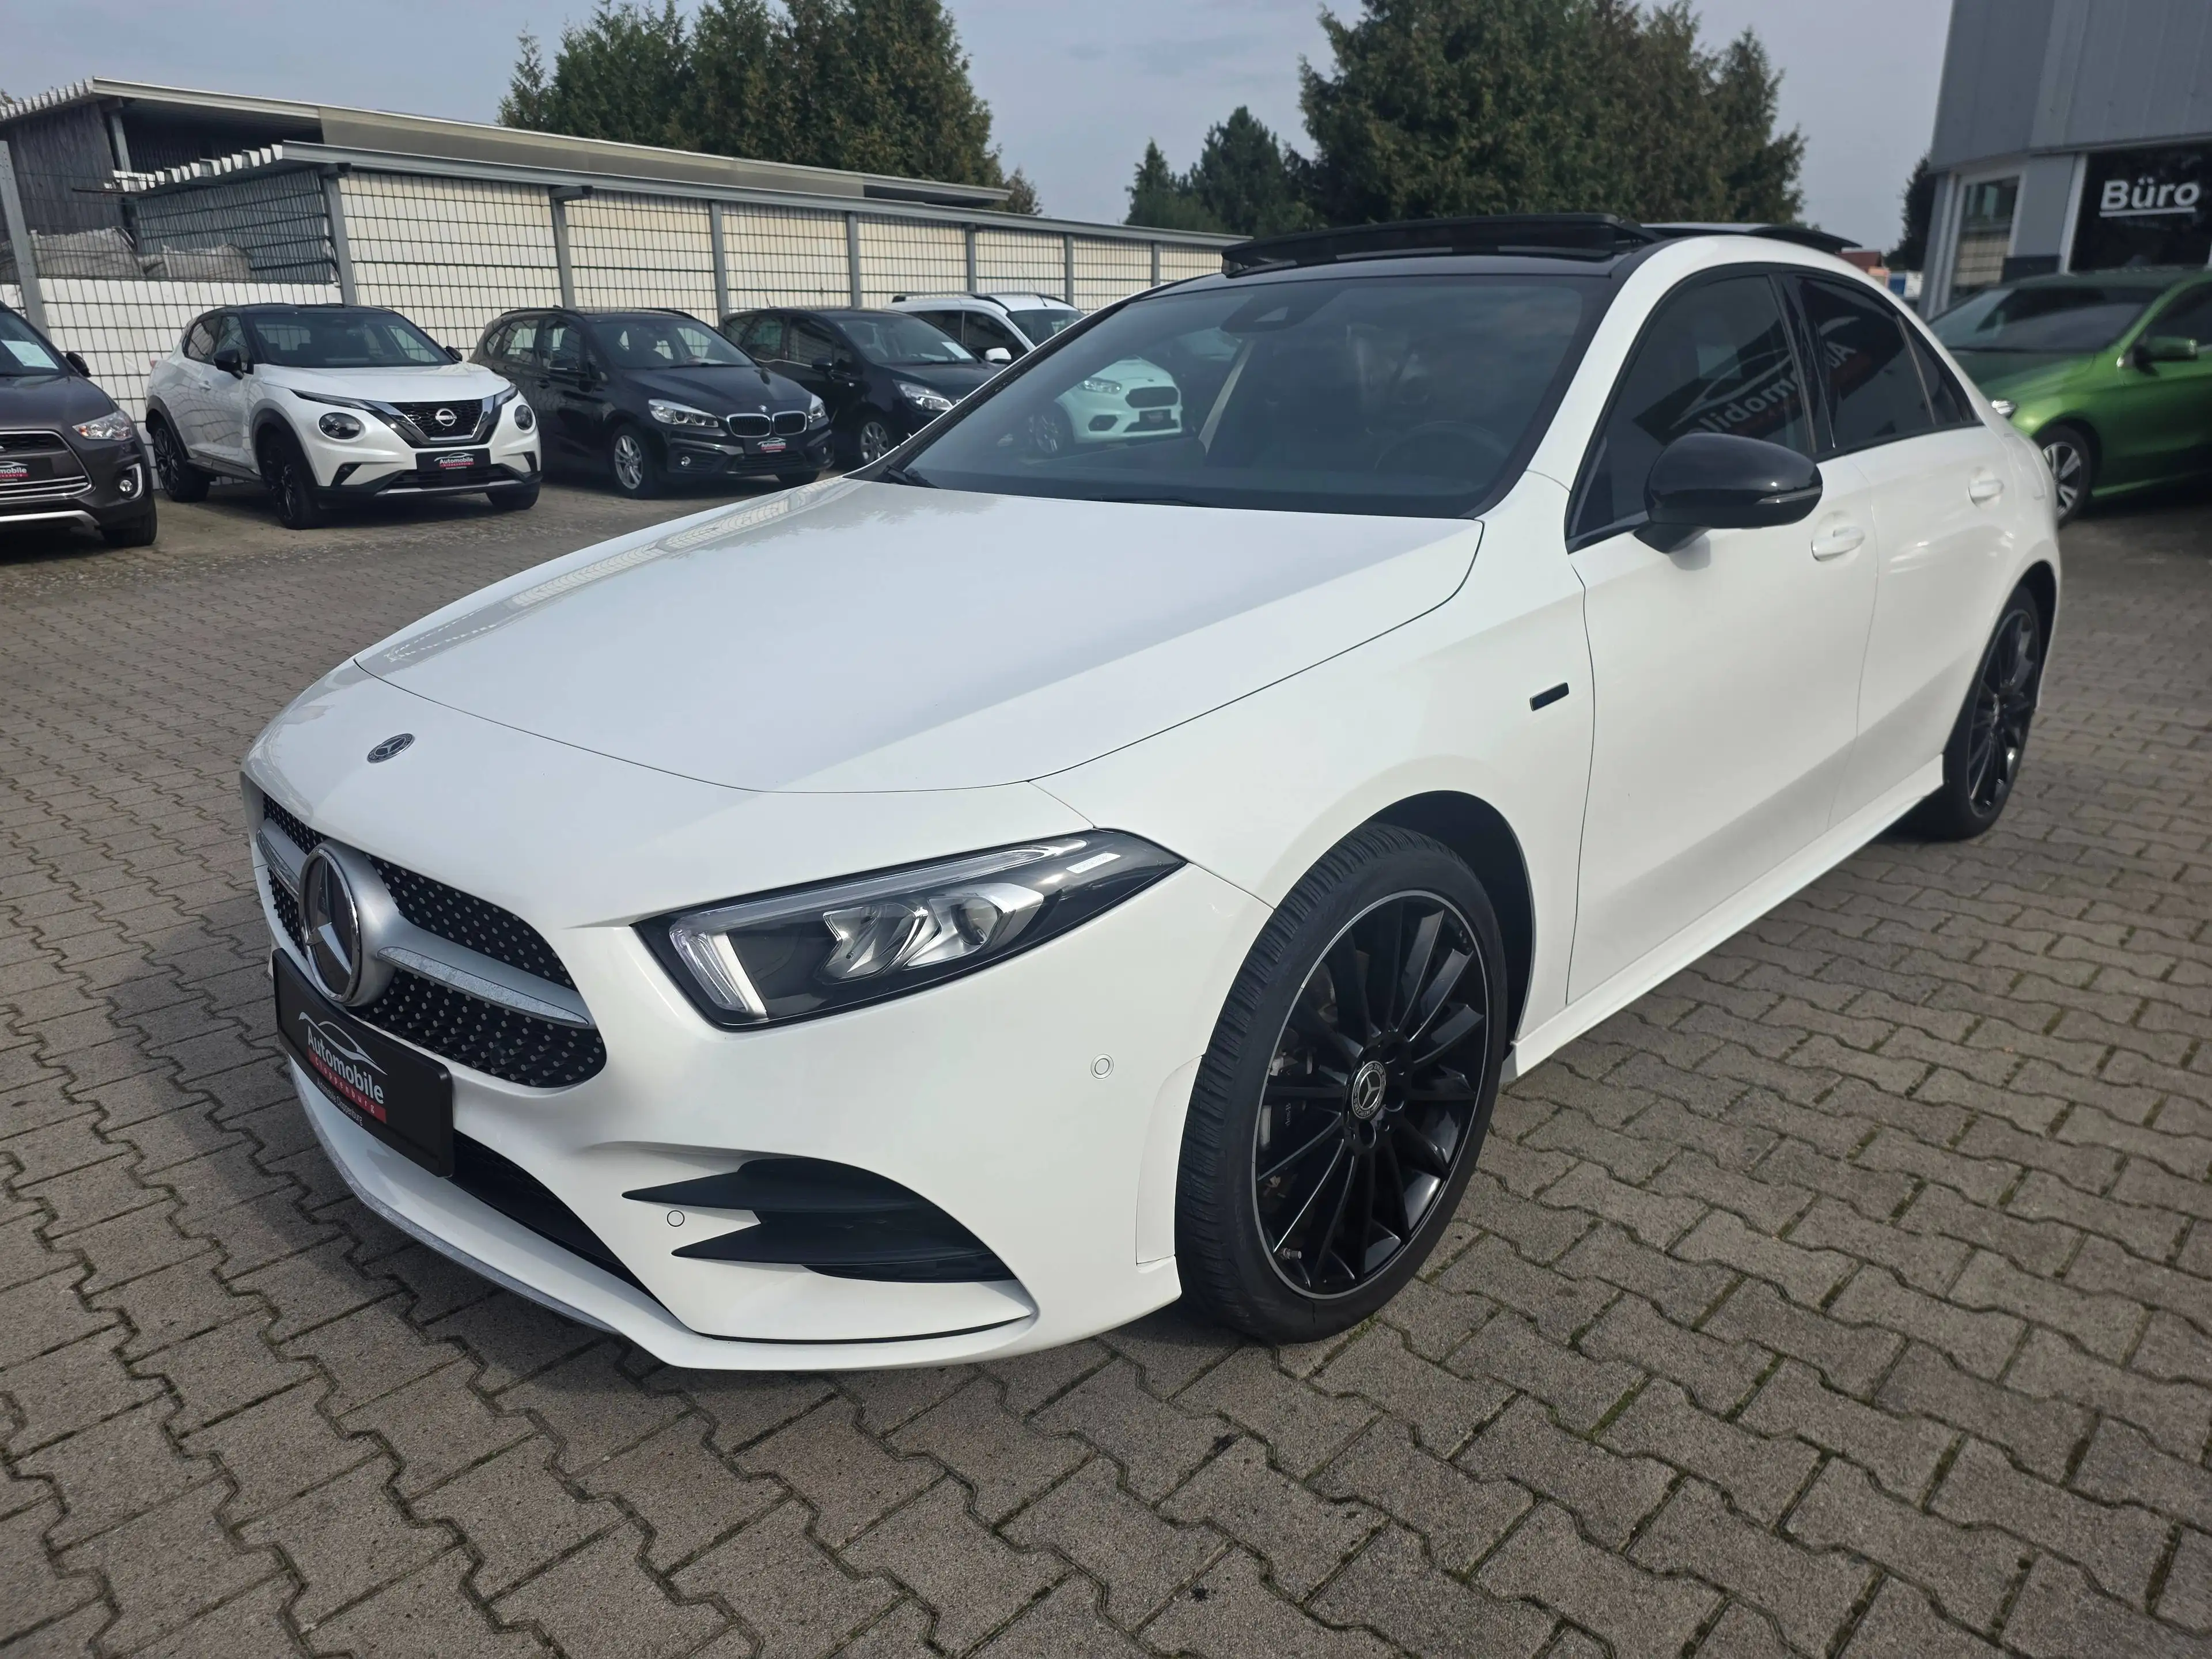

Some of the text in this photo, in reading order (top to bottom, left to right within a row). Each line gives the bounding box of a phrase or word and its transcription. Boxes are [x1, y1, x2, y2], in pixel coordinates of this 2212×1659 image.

[2100, 177, 2199, 210] Büro
[440, 456, 474, 464] Automobile
[308, 1025, 385, 1104] Automobile
